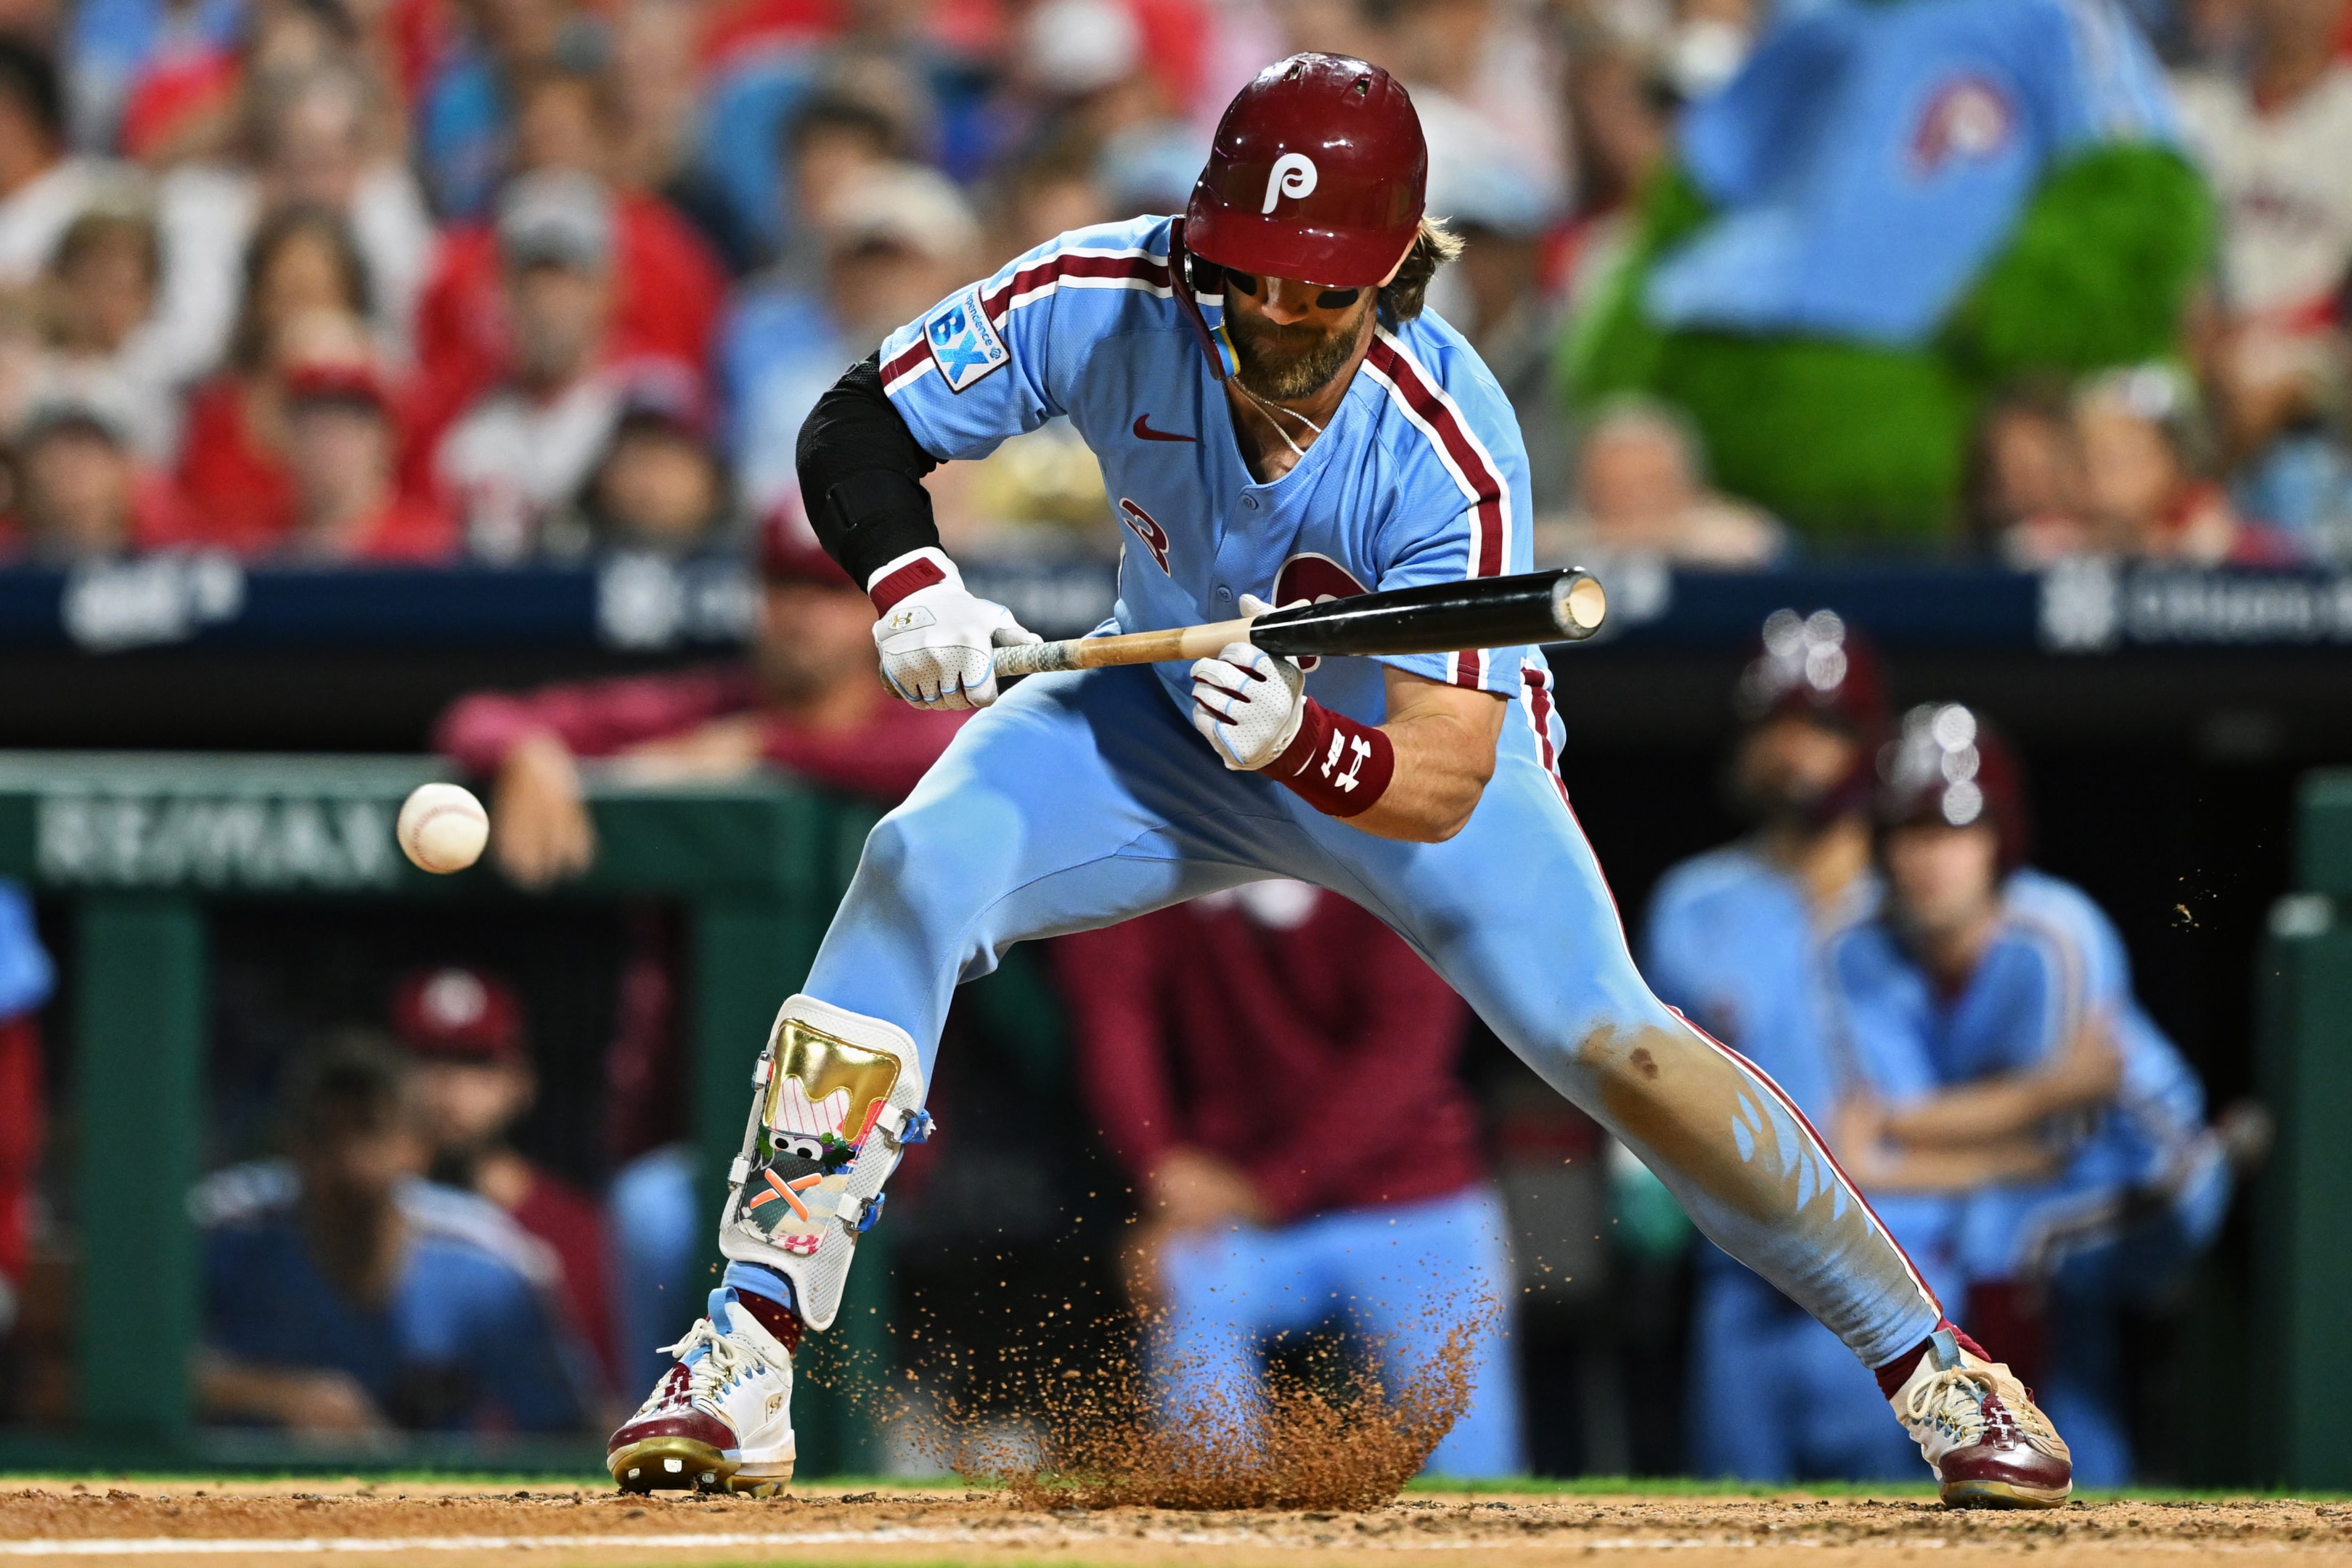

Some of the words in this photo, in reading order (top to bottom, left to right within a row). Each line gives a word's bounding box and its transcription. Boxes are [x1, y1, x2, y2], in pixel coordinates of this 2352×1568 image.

[1262, 152, 1318, 214] P
[928, 303, 990, 385] BX
[965, 292, 993, 347] ependence
